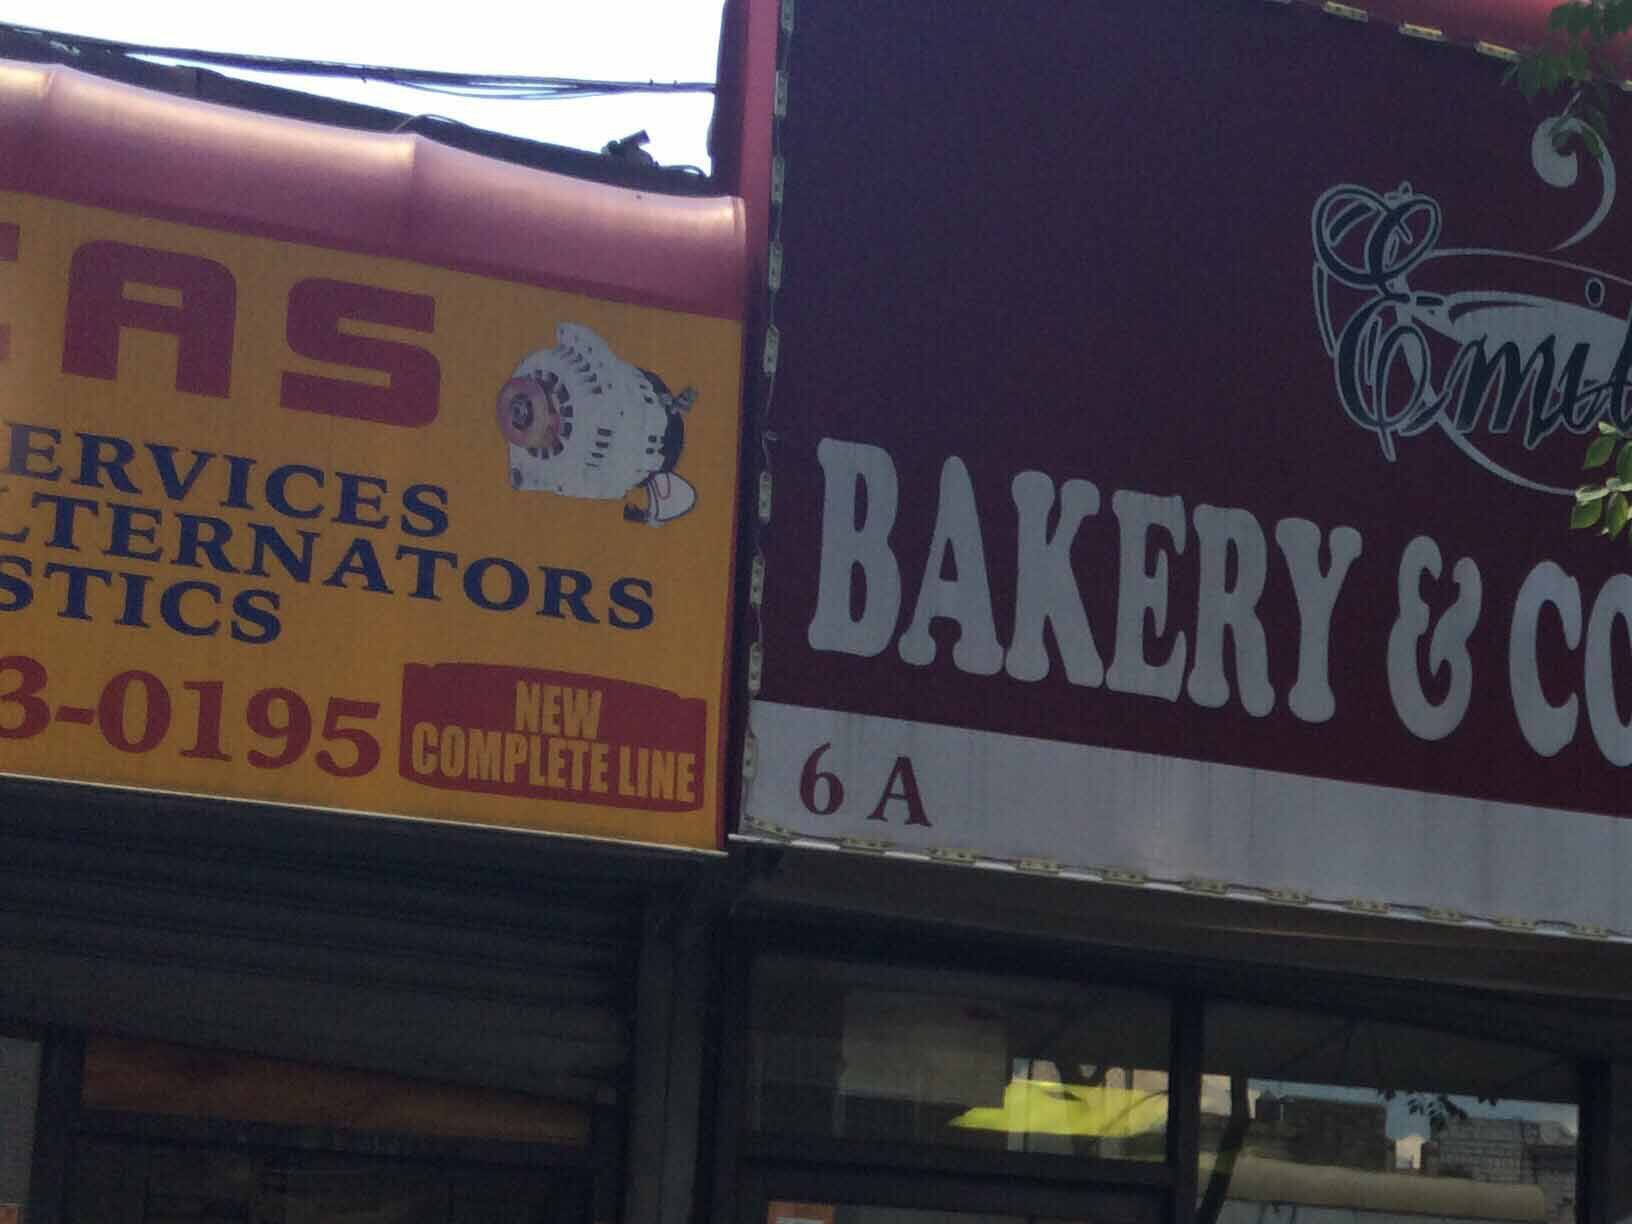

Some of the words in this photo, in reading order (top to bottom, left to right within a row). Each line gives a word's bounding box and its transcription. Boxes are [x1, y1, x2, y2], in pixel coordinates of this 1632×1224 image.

[0, 222, 441, 428] AS
[808, 437, 1362, 723] BAKERY
[1388, 535, 1482, 741] &
[515, 680, 602, 741] NEW
[411, 722, 608, 794] COMPLETE
[618, 746, 695, 802] LINE
[800, 743, 844, 816] 6
[867, 756, 932, 827] A
